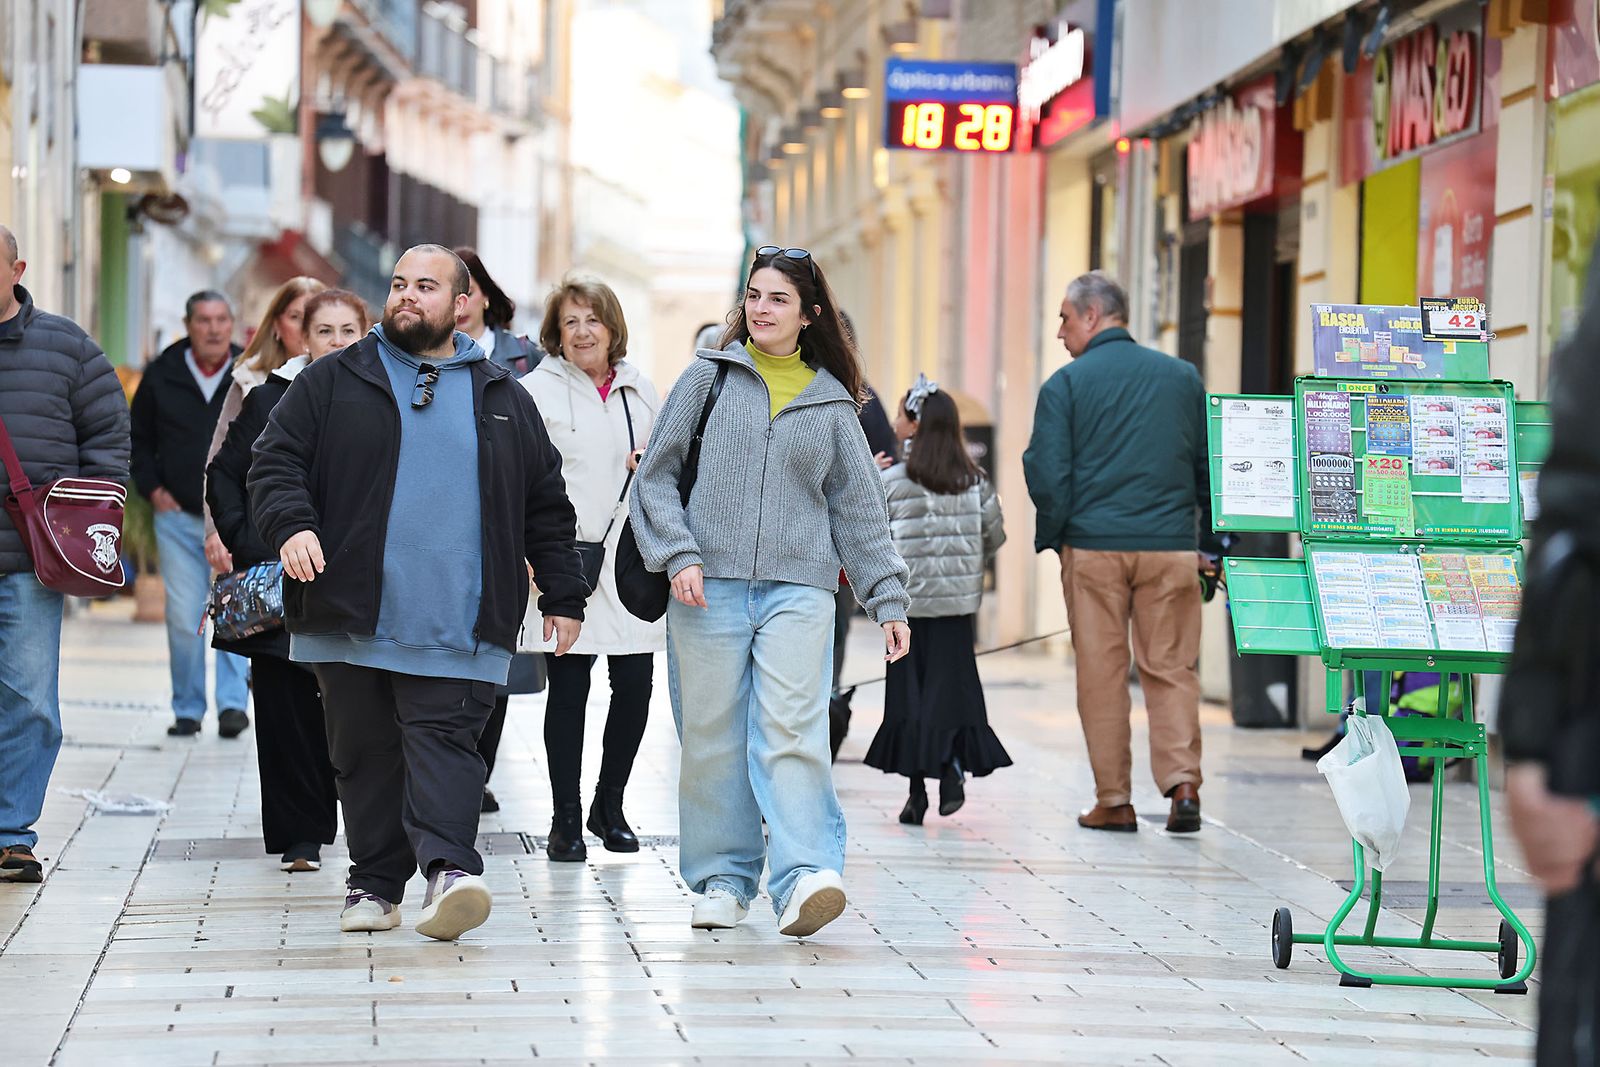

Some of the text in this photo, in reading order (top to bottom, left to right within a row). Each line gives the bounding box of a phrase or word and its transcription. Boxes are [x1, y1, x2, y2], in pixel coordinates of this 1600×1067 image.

[902, 103, 1013, 151] 18 28
[1320, 312, 1365, 327] RASCA
[1448, 314, 1476, 328] 42
